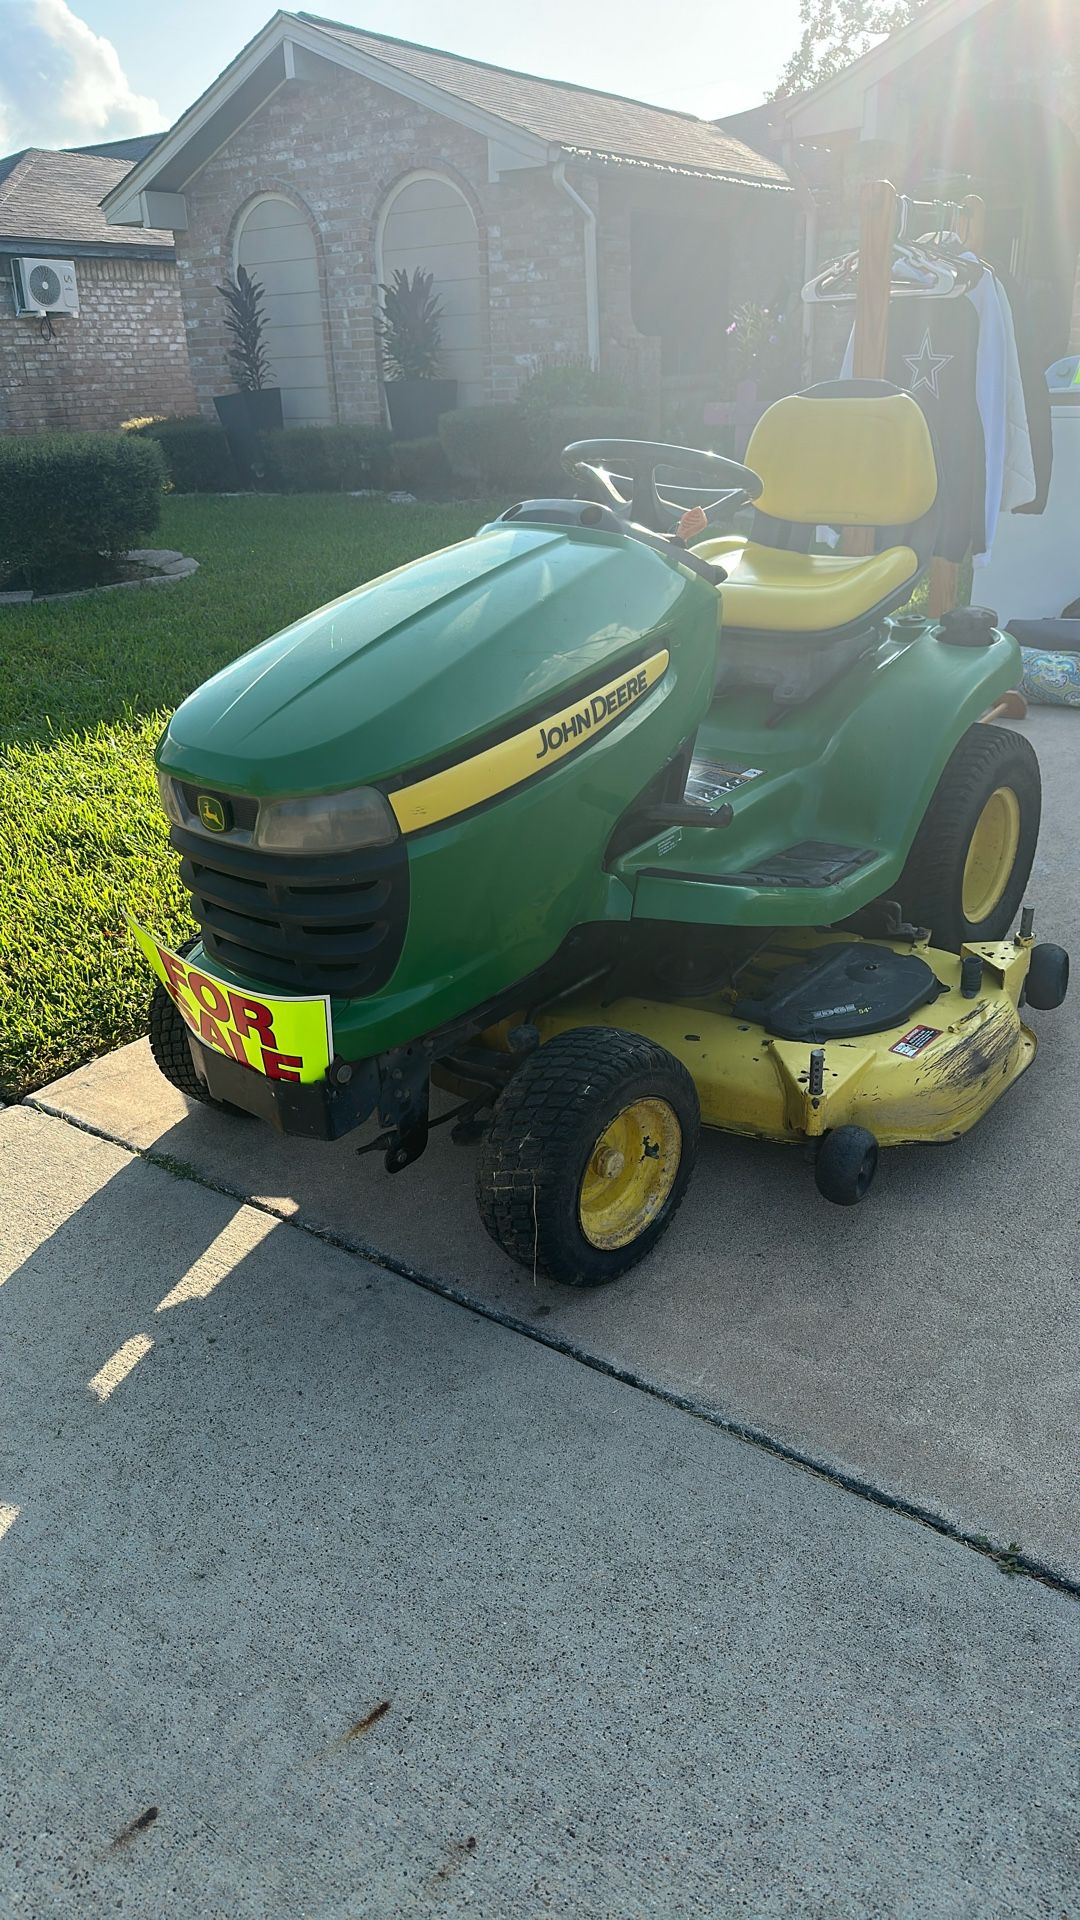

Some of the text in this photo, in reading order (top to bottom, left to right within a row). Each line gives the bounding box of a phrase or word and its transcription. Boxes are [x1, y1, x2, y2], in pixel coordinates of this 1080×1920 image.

[536, 669, 648, 759] JOHN DEERE
[156, 945, 278, 1050] FOR
